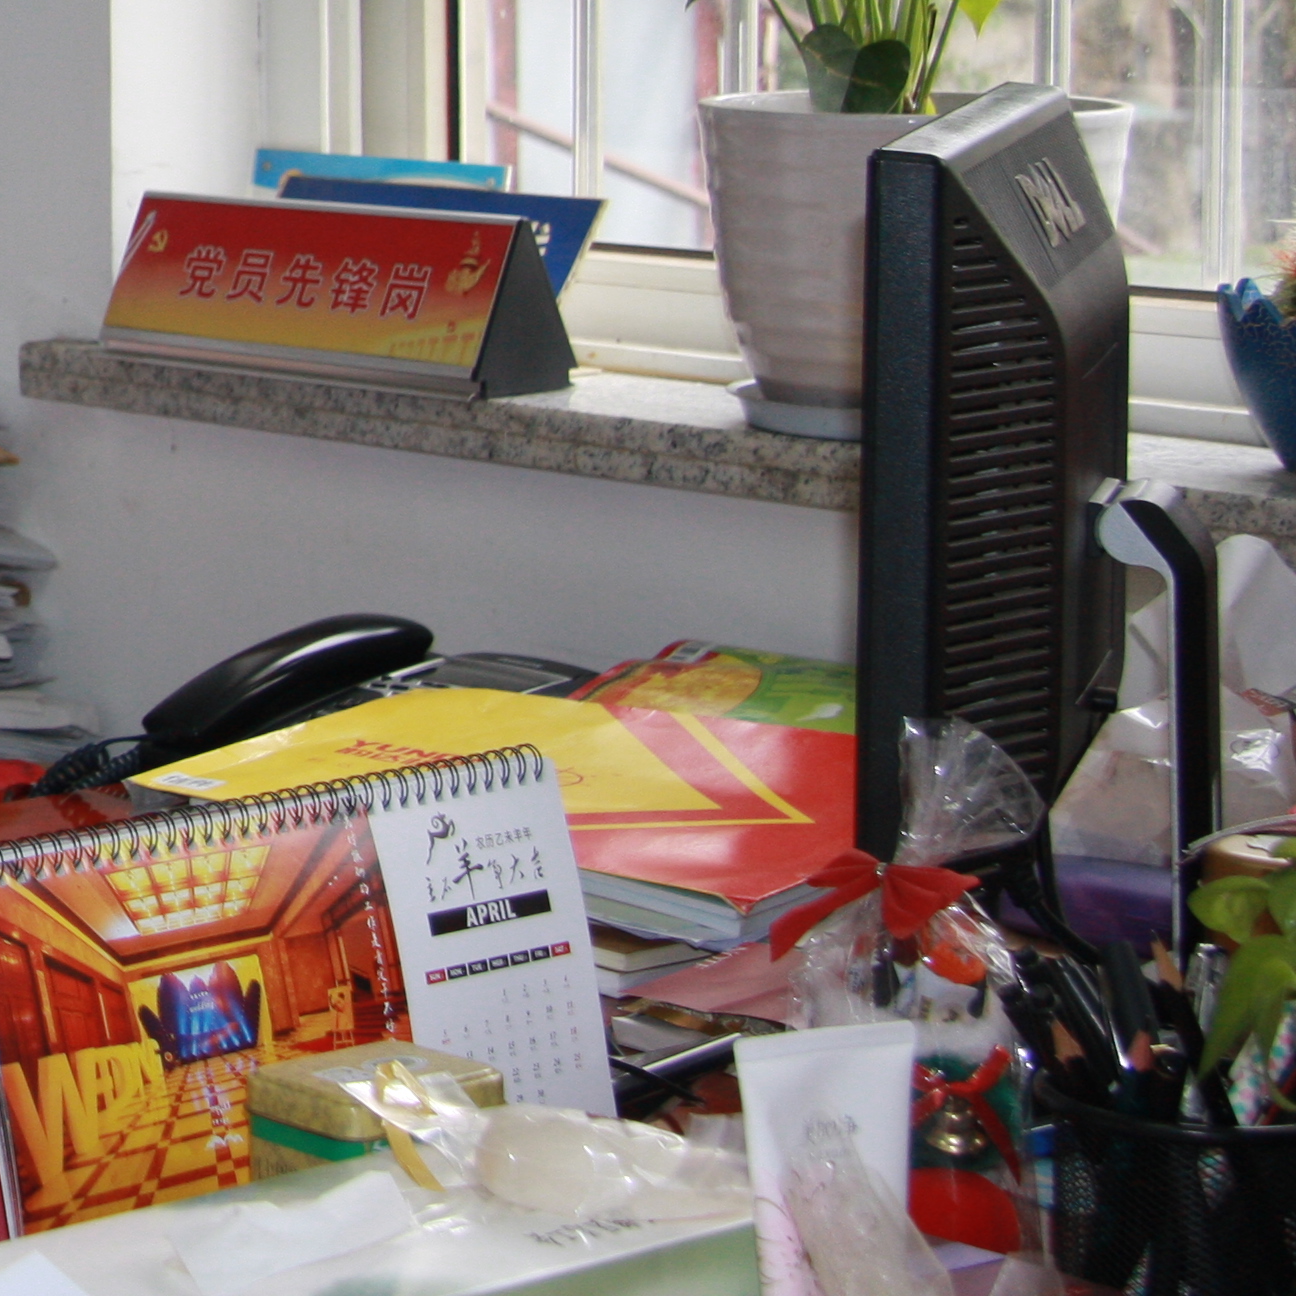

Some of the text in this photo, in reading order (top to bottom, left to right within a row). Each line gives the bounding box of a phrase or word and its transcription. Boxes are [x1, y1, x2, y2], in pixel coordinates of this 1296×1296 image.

[1015, 157, 1086, 248] DELL
[179, 244, 433, 320] 党员先锋岗
[475, 826, 532, 850] 农历乙未羊年
[466, 899, 517, 928] APRIL
